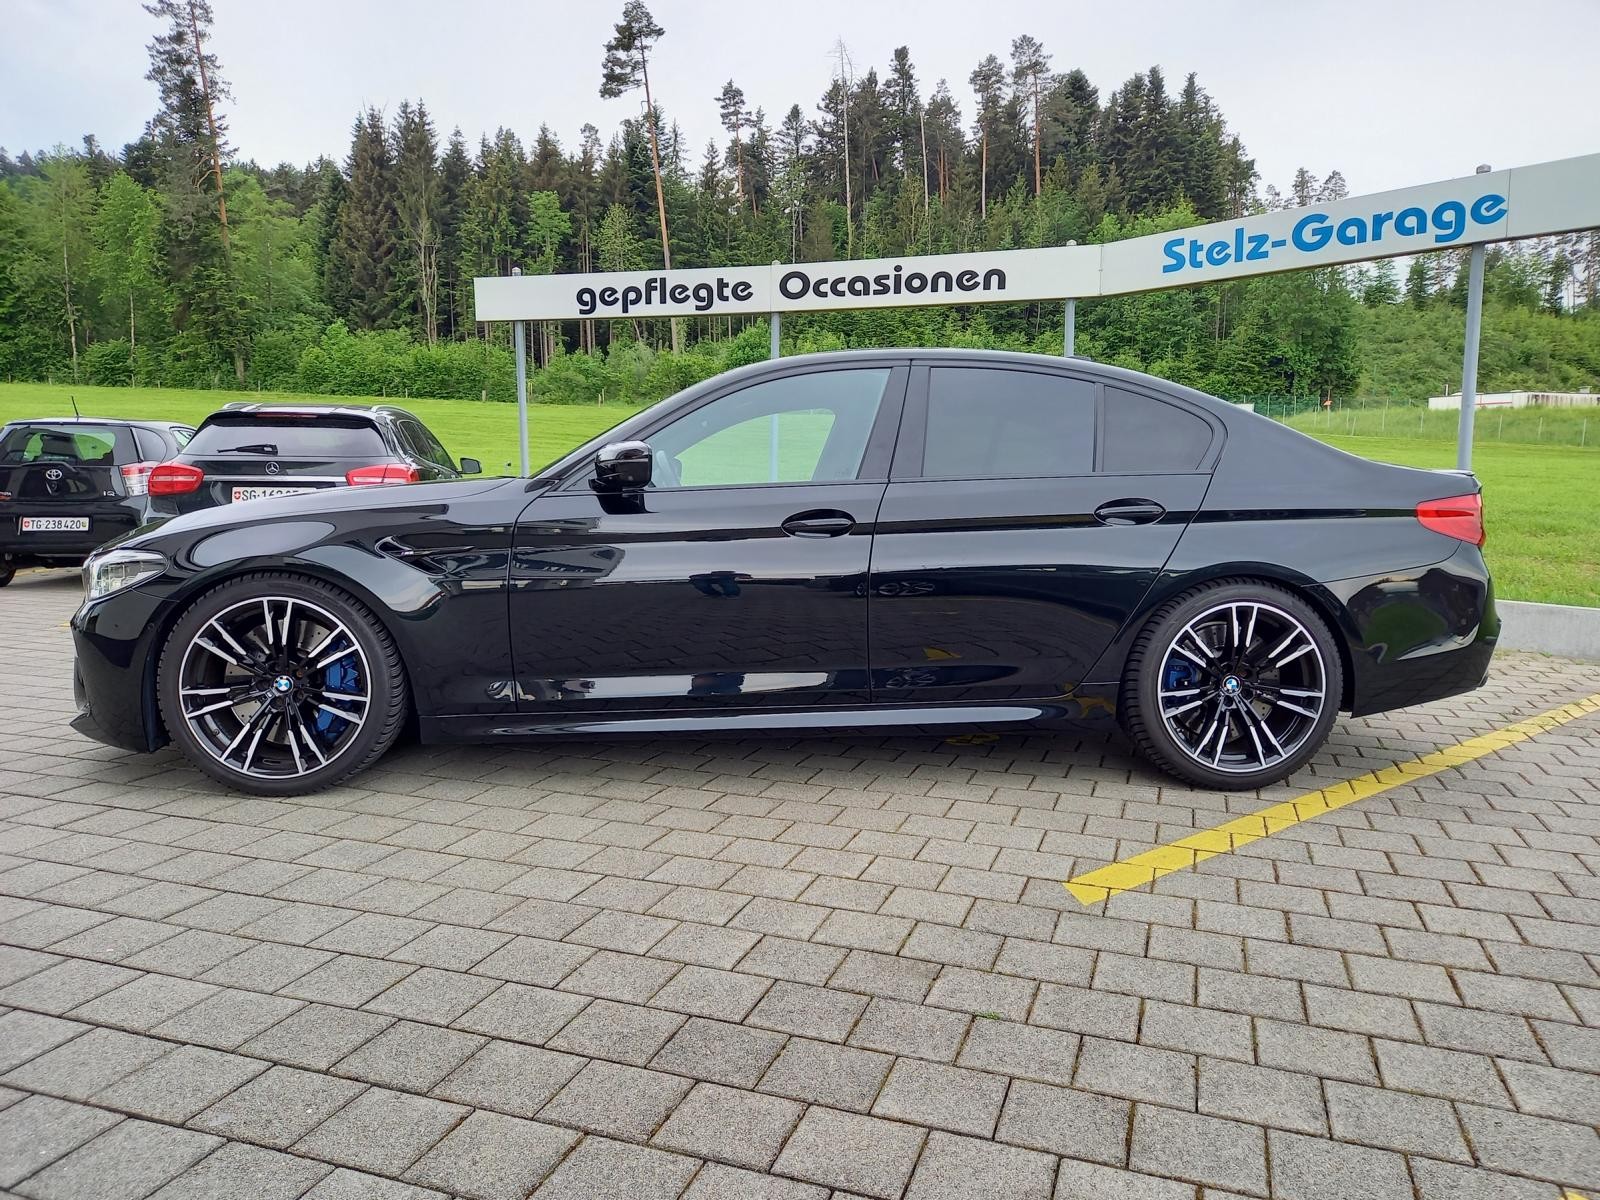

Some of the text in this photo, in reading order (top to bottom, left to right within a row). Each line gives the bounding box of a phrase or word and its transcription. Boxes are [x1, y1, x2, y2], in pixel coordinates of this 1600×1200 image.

[1162, 194, 1508, 273] Stelz-Garage
[576, 264, 1006, 315] gepflegte Occasionen
